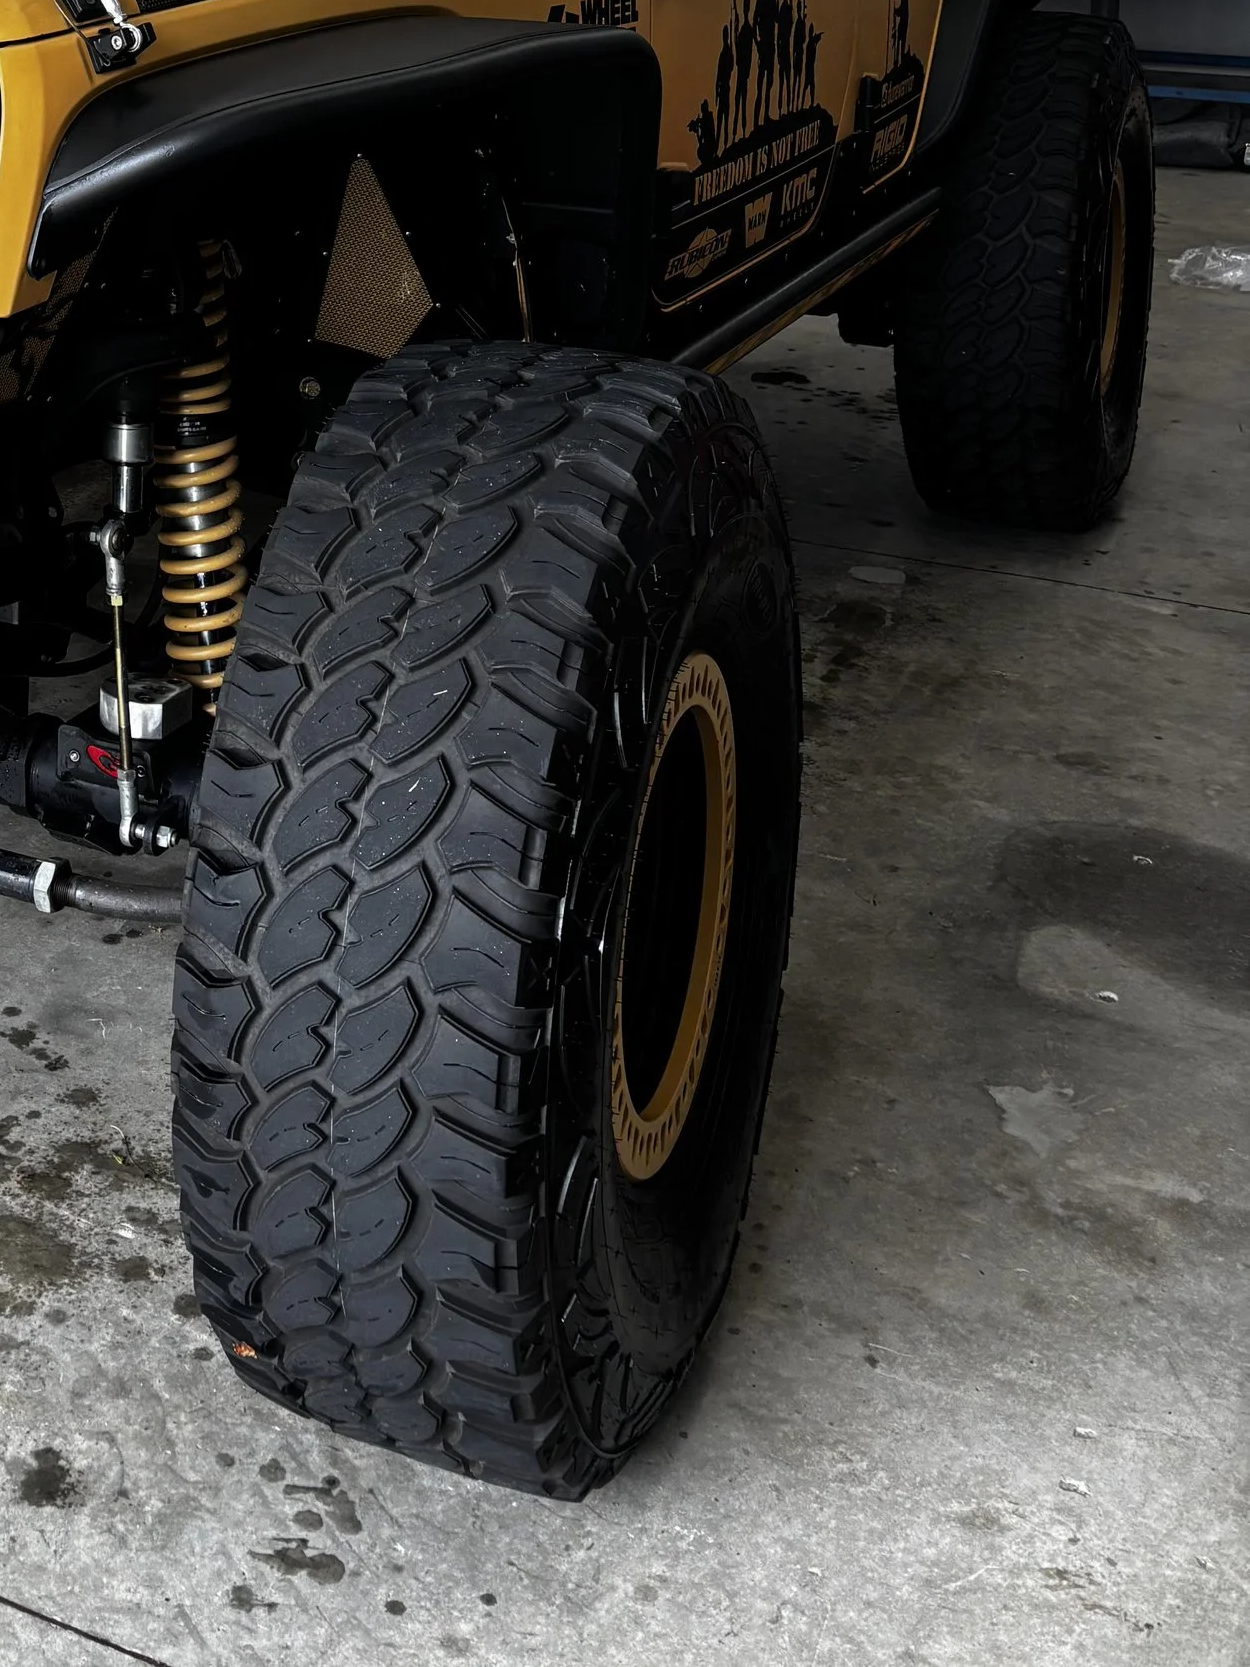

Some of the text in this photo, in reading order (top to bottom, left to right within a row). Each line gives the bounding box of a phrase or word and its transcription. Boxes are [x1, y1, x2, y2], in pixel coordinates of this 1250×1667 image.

[693, 119, 821, 207] FREEDOM IS NOT FREE
[780, 167, 818, 215] KMC
